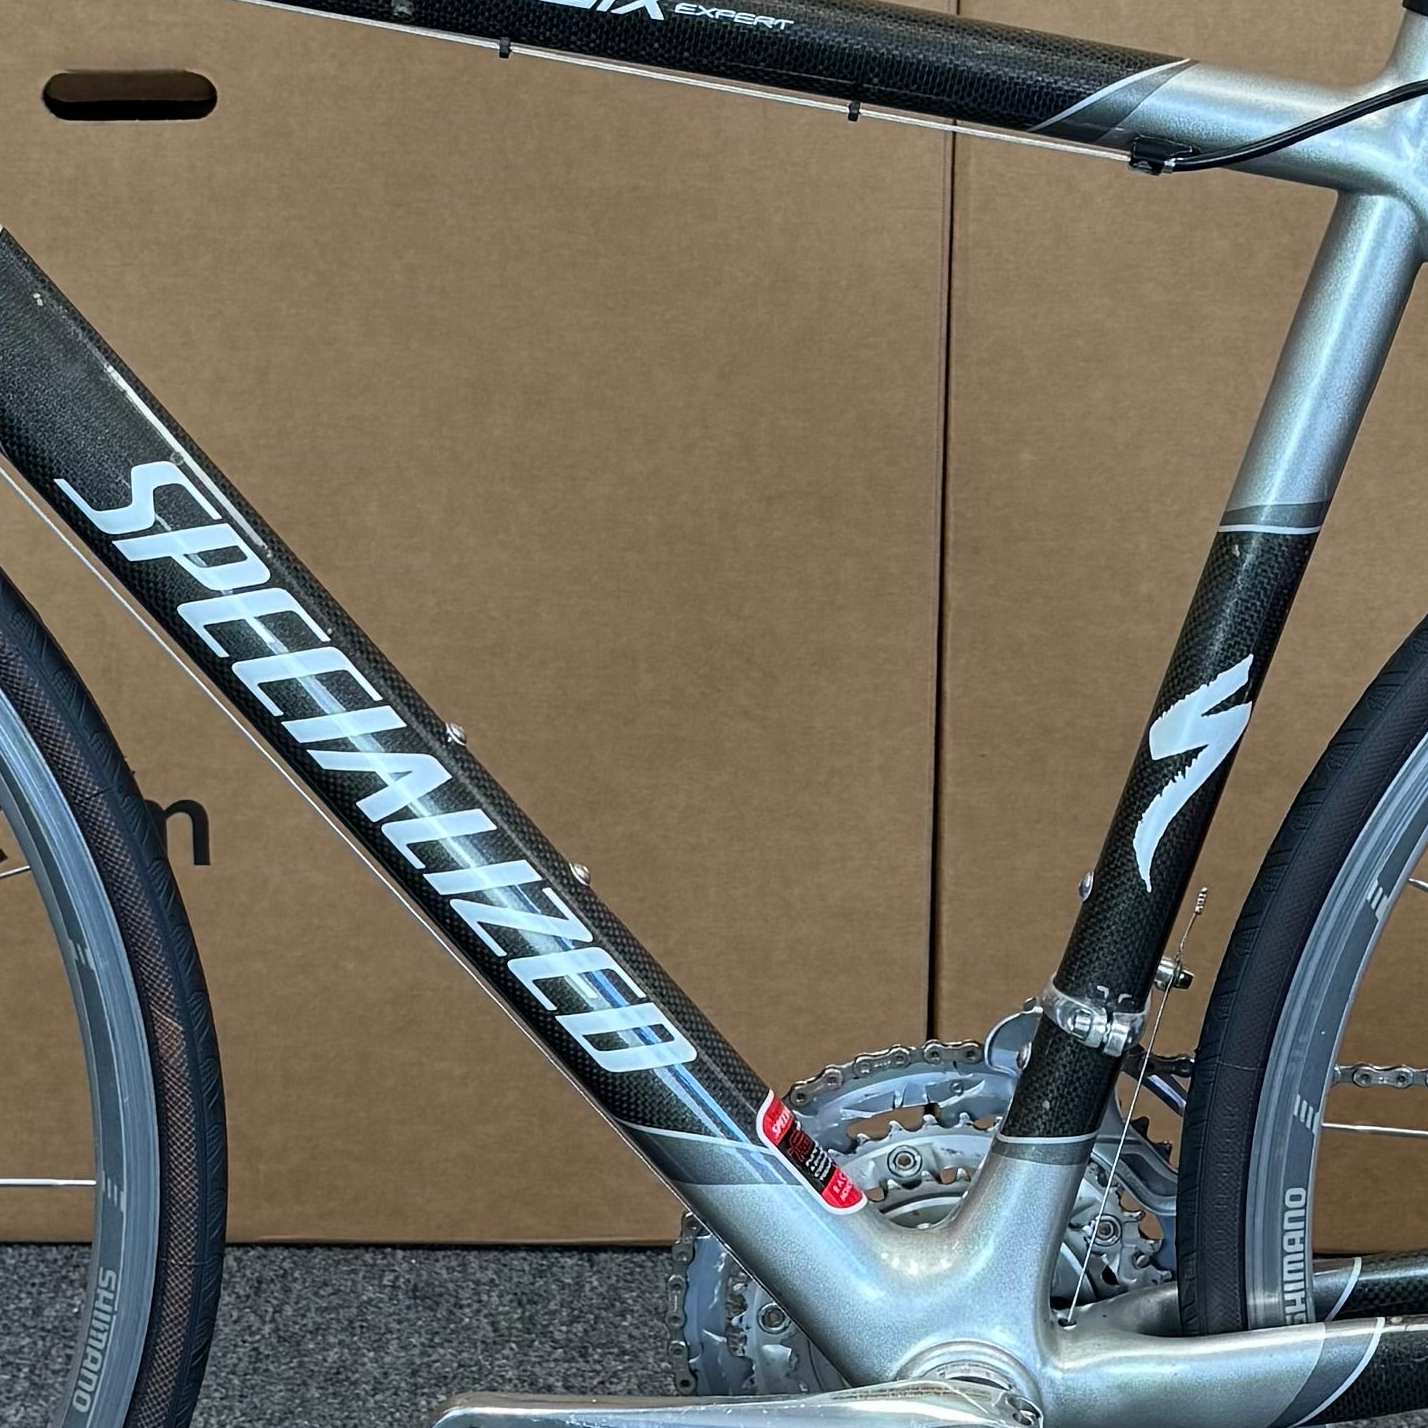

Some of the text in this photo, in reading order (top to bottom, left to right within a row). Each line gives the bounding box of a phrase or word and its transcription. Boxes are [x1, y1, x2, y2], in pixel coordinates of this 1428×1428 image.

[674, 2, 794, 30] EXPERT
[54, 460, 698, 1072] SPECIALIZED
[72, 1267, 117, 1413] SHIMANO
